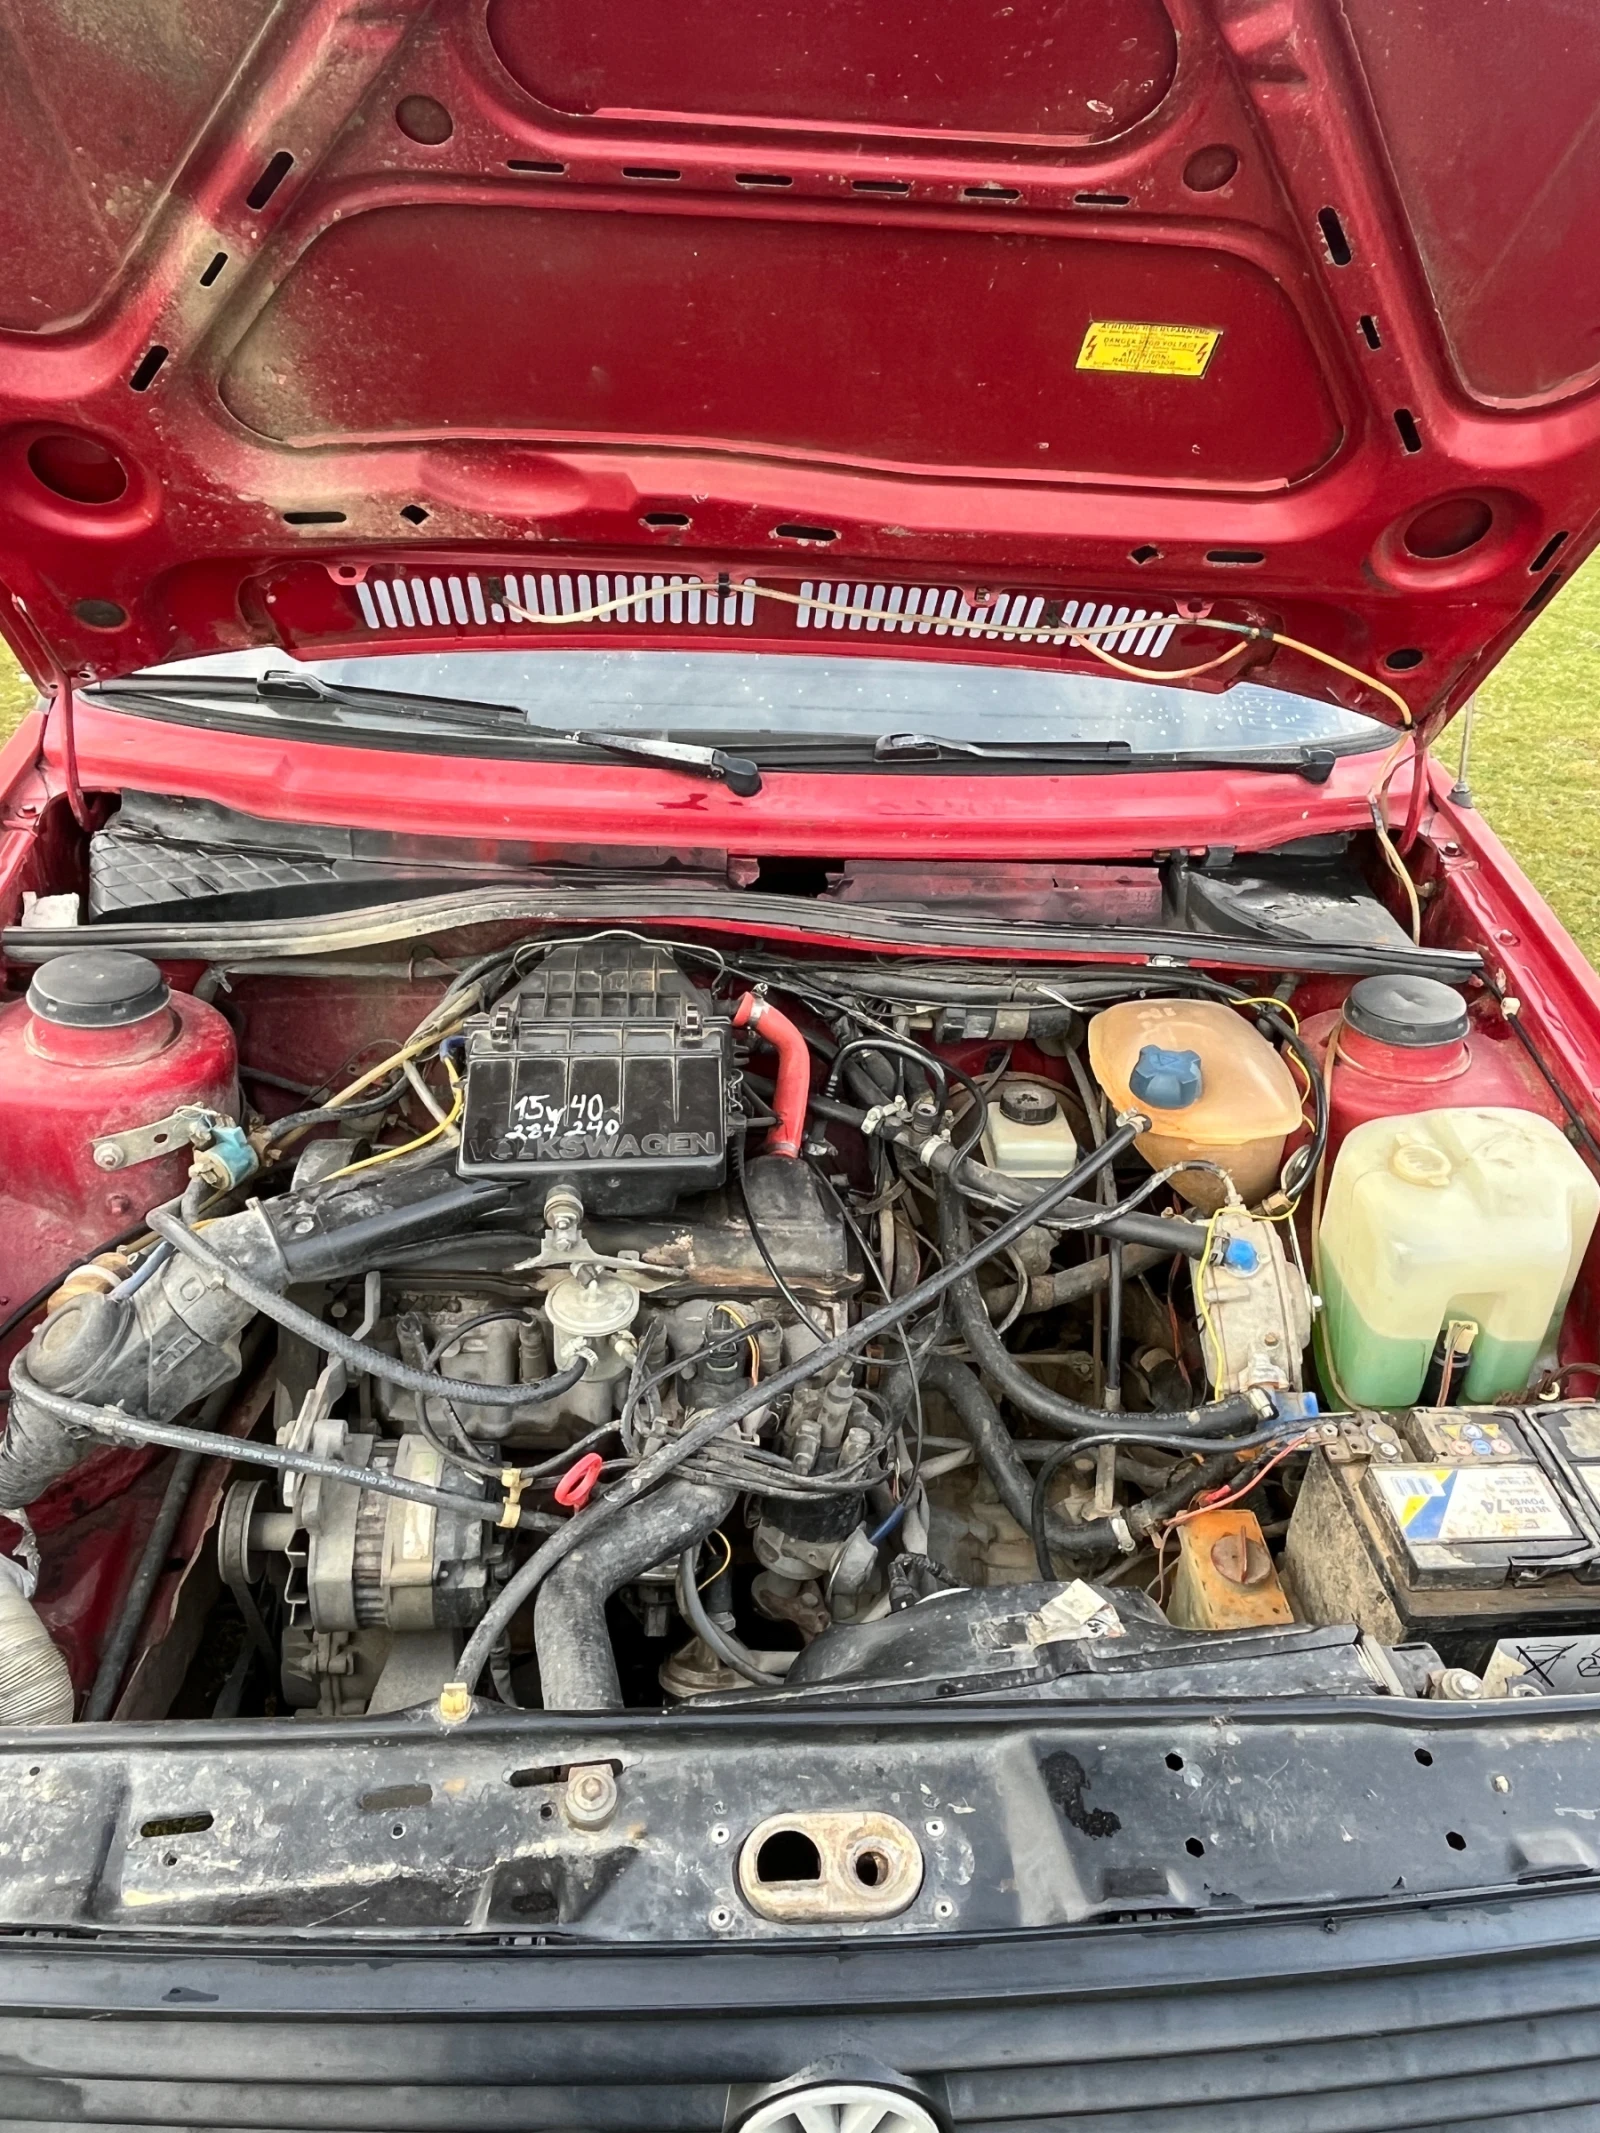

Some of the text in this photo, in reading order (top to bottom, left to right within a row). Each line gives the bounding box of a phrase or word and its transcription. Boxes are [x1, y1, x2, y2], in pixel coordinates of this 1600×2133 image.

[1104, 337, 1136, 345] DANGER
[1163, 340, 1198, 349] VOLTAGE
[570, 1094, 604, 1121] 40
[563, 1119, 620, 1137] 240
[469, 1132, 716, 1162] VOLKSWAGEN
[1480, 1499, 1511, 1514] 74
[1507, 1498, 1545, 1506] POWER
[1515, 1505, 1552, 1514] ULTRA
